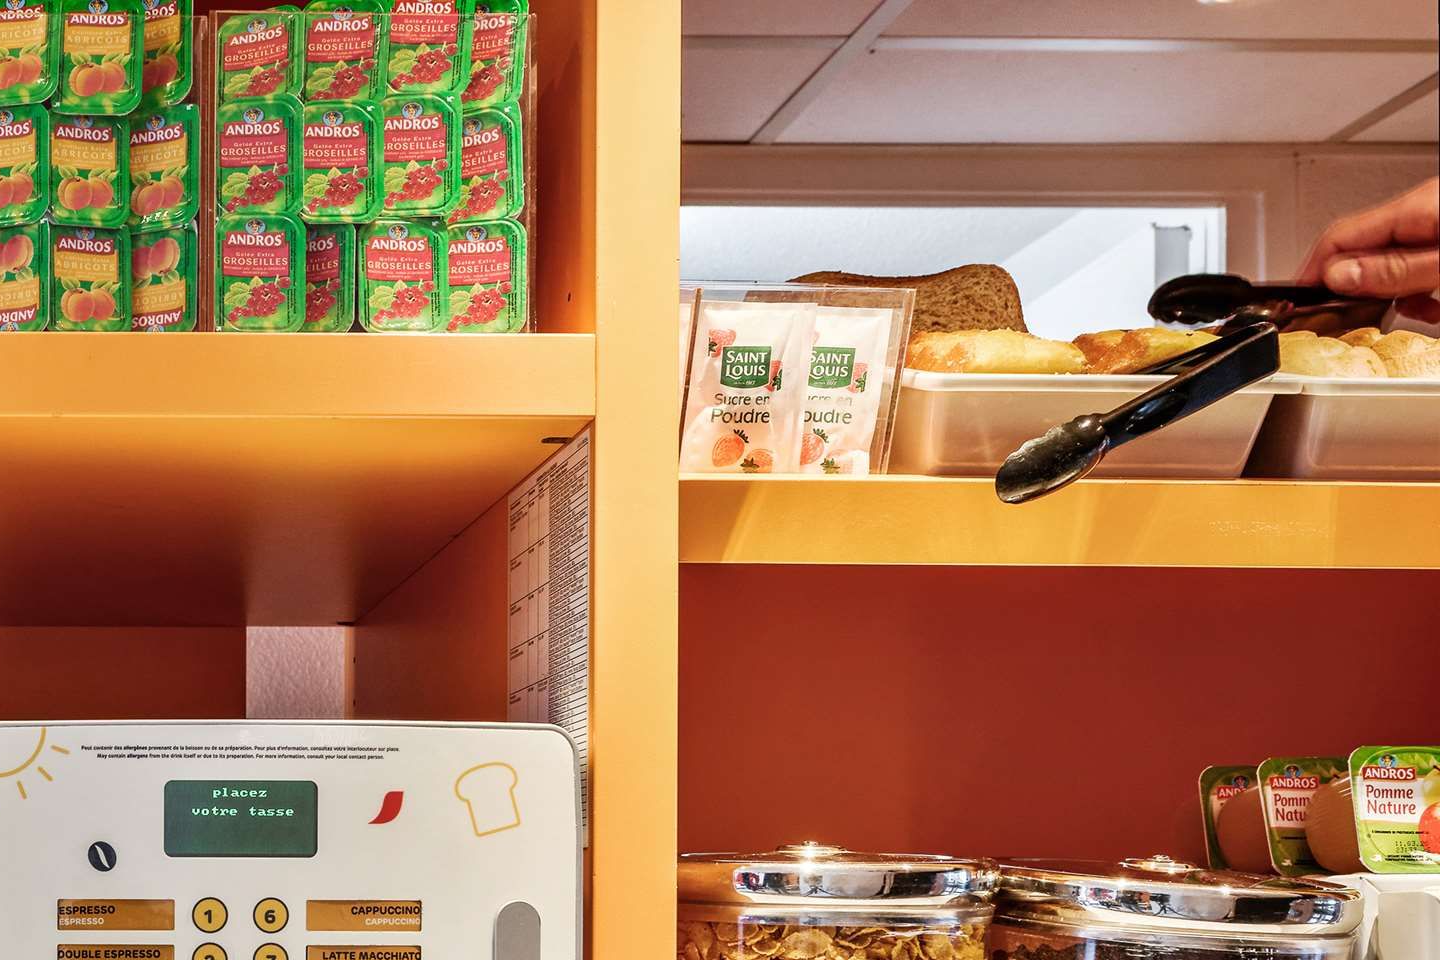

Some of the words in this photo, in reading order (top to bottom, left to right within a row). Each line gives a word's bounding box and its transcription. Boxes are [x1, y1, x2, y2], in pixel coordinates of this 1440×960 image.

[144, 4, 176, 20] DROS
[396, 2, 452, 14] ANDROS
[70, 14, 125, 25] ANDROS
[314, 18, 370, 32] ANDROS
[474, 15, 504, 31] DROS
[390, 23, 456, 32] GROSEILLES
[230, 26, 283, 46] ANDROS
[308, 40, 374, 52] GROSEILLES
[472, 38, 510, 50] SEILLES
[224, 44, 288, 63] GROSEILLES
[226, 122, 281, 136] ANDROS
[384, 116, 440, 130] ANDROS
[56, 126, 110, 142] ANDROS
[130, 125, 180, 144] ANDROS
[306, 126, 360, 138] ANDROS
[462, 129, 500, 148] DROS
[220, 144, 286, 156] GROSEILLES
[384, 140, 446, 150] ROSEILLES
[304, 148, 366, 158] GROSEILLES
[462, 150, 506, 168] OSEILLES
[58, 238, 110, 253] ANDROS
[228, 234, 282, 246] ANDROS
[371, 239, 426, 252] ANDROS
[448, 241, 504, 254] ANDROS
[223, 256, 288, 266] GROSEILLES
[367, 260, 432, 270] GROSEILLES
[450, 262, 510, 274] ROSEILLES
[726, 350, 768, 364] SAINT
[725, 364, 766, 380] LOUIS
[714, 393, 752, 406] Sucre
[710, 408, 770, 424] Poudre
[1364, 768, 1415, 780] ANDROS
[1272, 778, 1318, 788] ANDROS
[212, 788, 268, 799] placez
[1366, 784, 1414, 799] Pomme
[1274, 794, 1310, 806] Pomm
[192, 806, 238, 817] votre
[248, 806, 294, 817] tasse
[1367, 800, 1416, 815] Nature
[1275, 808, 1306, 822] Natu
[59, 905, 116, 915] ESPRESSO
[351, 906, 420, 916] CAPPUCCINO
[59, 917, 104, 926] ESPRESSO
[204, 909, 212, 924] 1
[264, 909, 276, 924] 6
[58, 950, 102, 959] DOUBLE
[104, 950, 160, 958] ESPRESSO
[322, 951, 356, 960] LATTE
[358, 951, 420, 960] MACCHIATO
